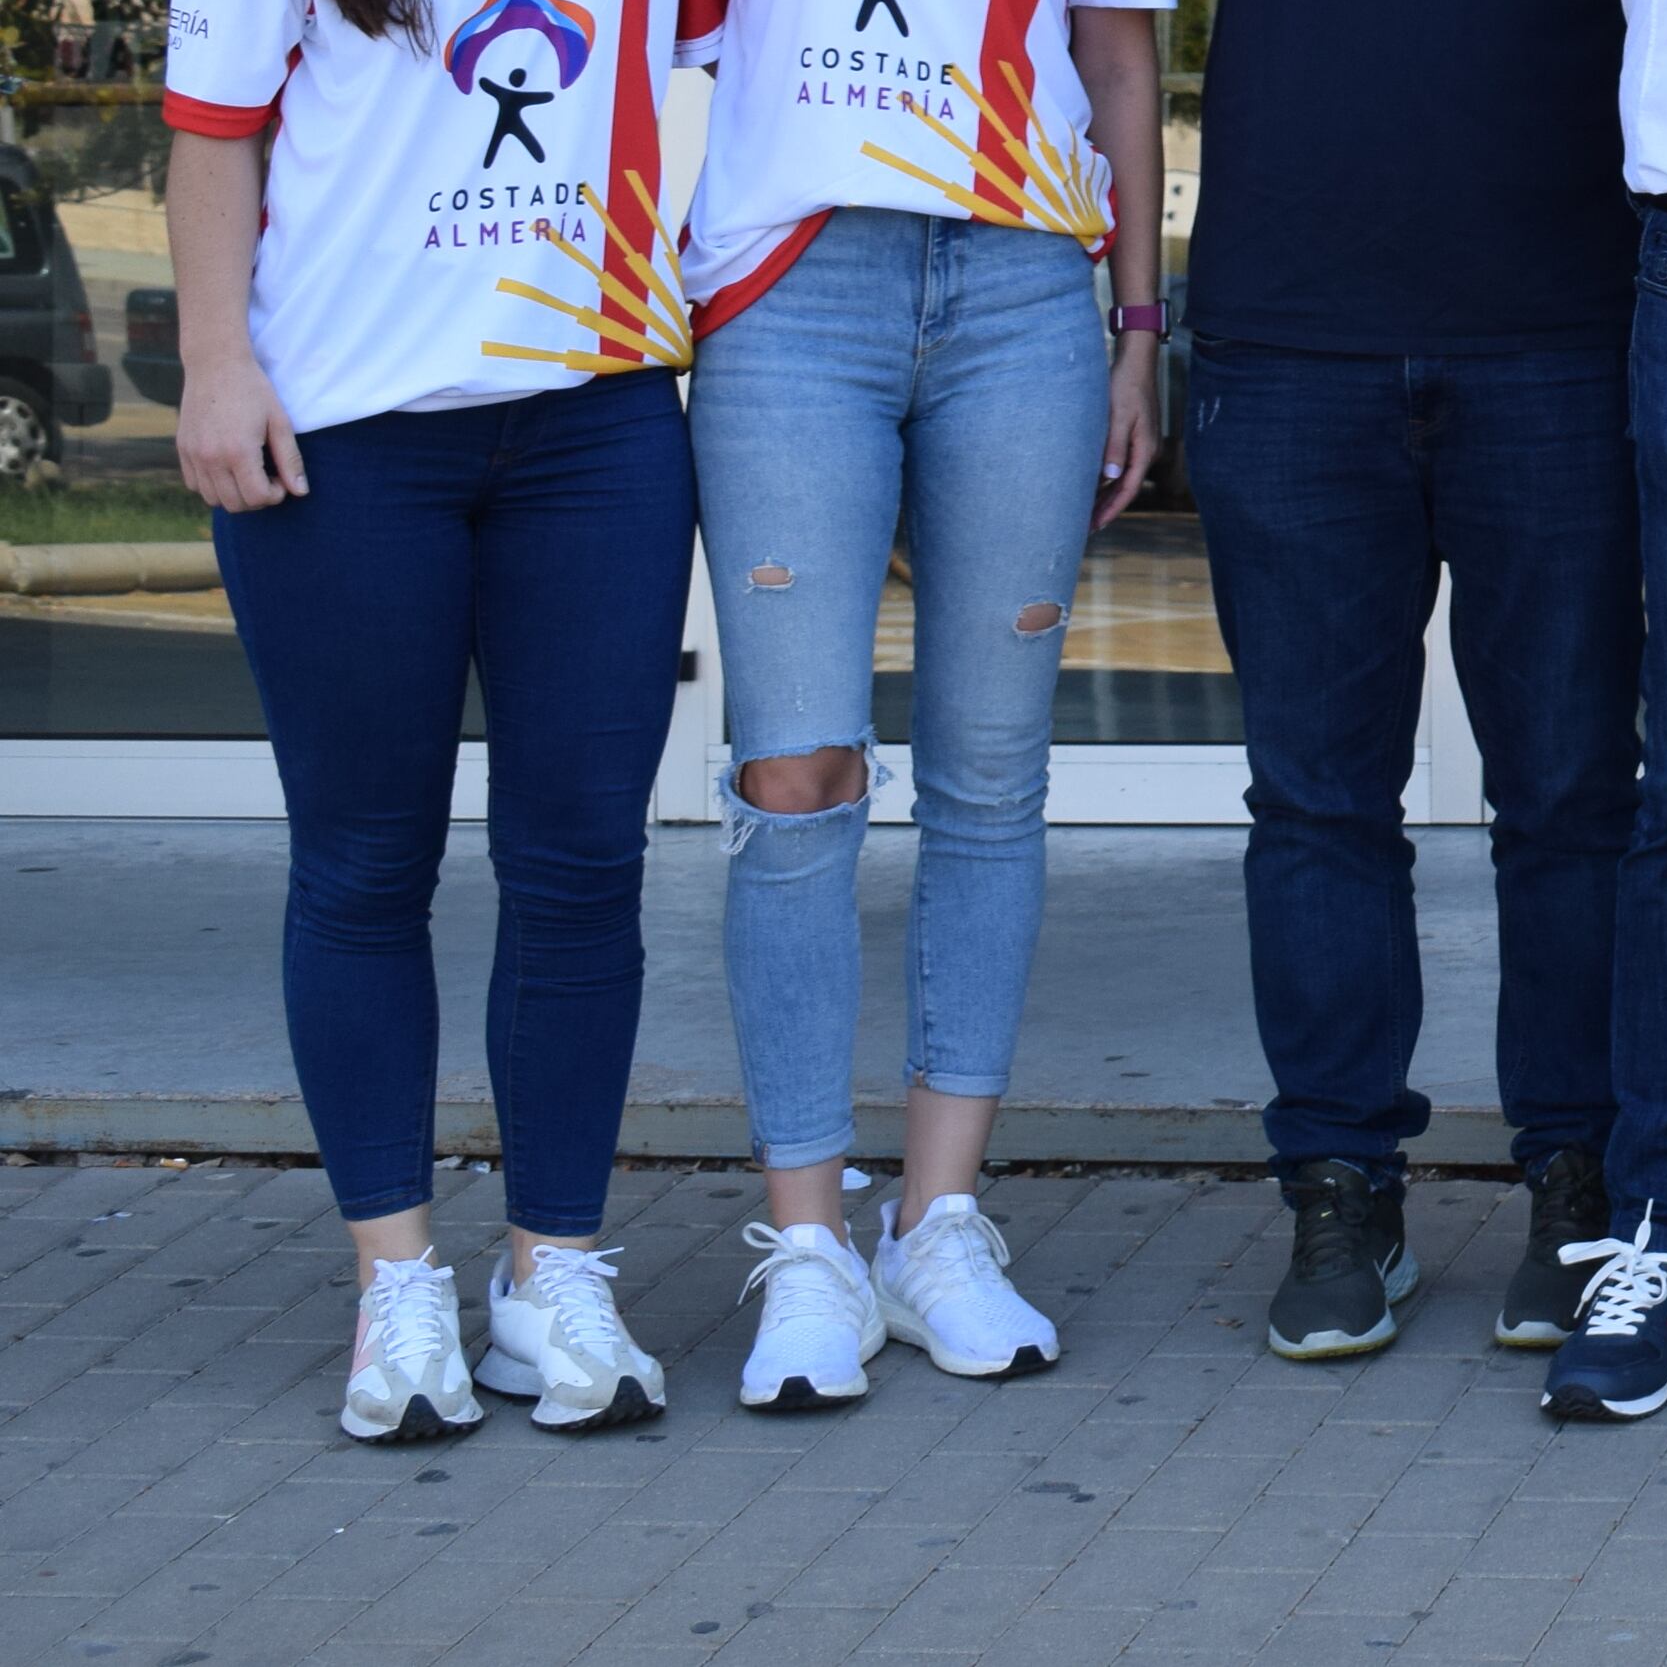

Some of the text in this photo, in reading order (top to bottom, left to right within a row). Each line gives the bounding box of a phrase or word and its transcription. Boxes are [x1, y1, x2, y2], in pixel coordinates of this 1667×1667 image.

[169, 8, 209, 39] ERÍA
[797, 81, 955, 120] ALMERÍA
[424, 212, 586, 249] ALMERÍA
